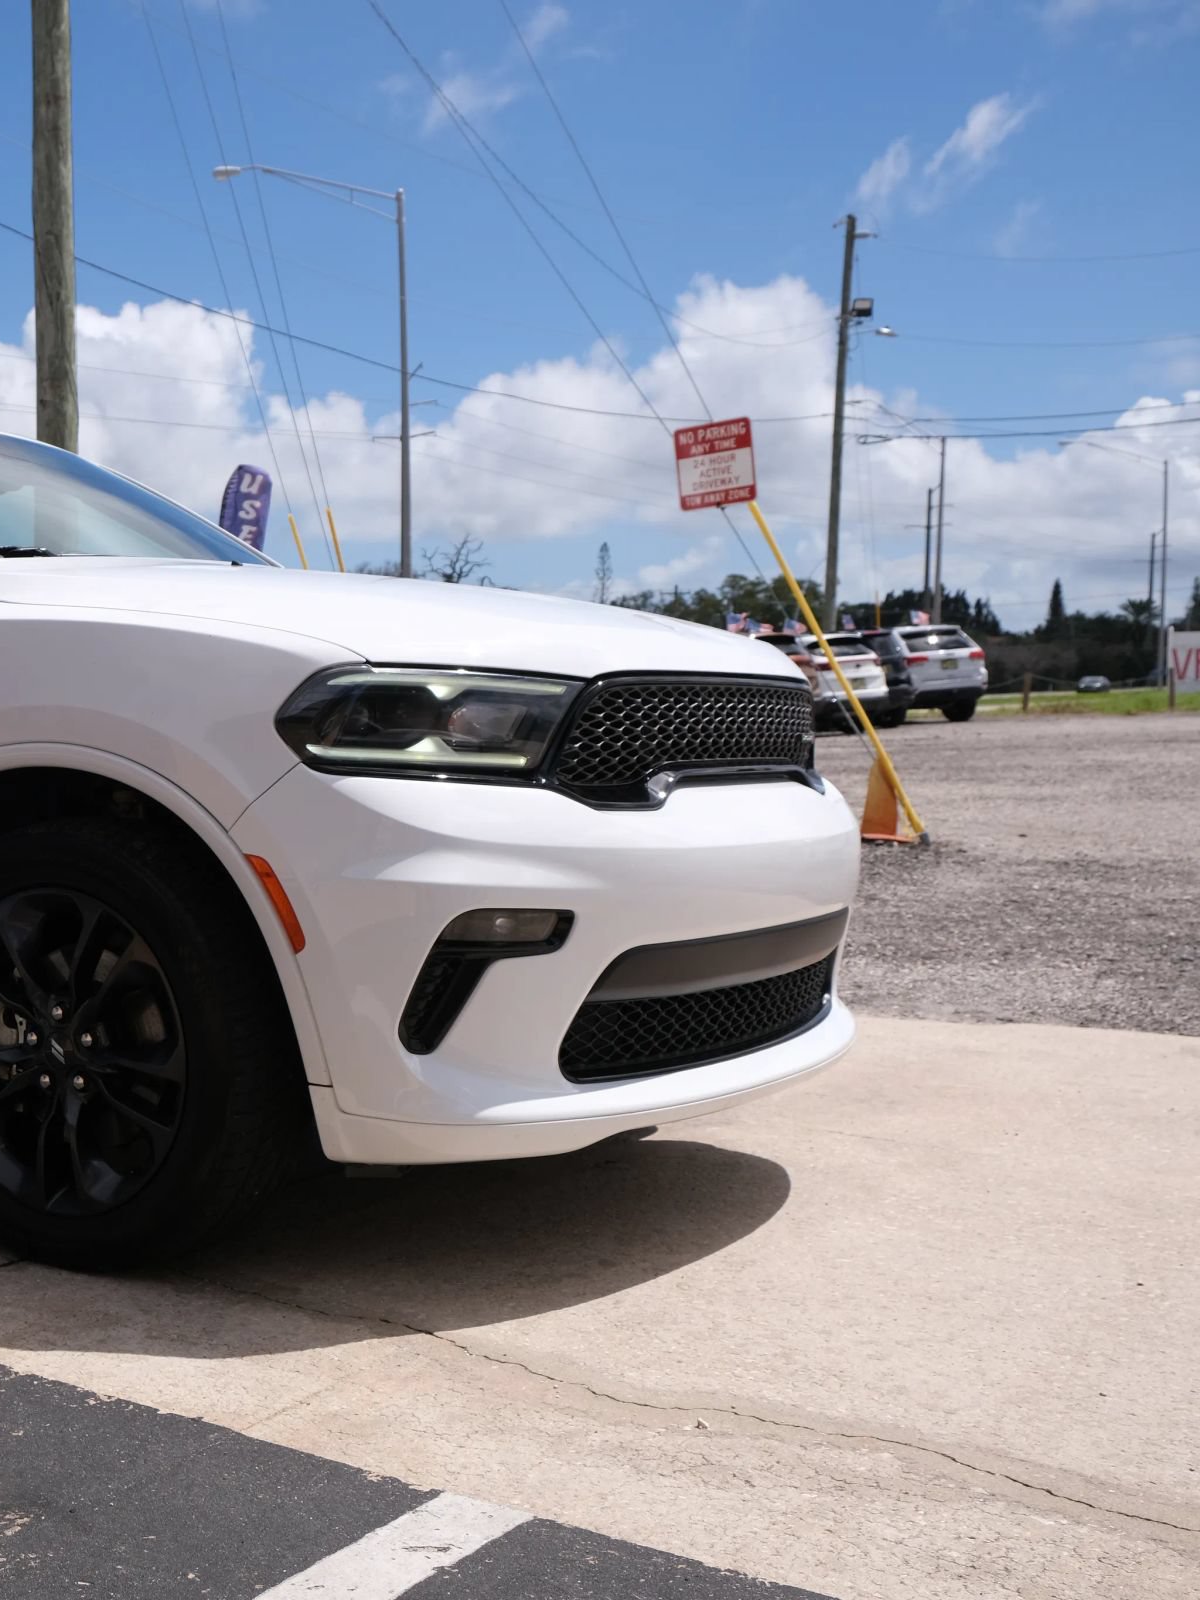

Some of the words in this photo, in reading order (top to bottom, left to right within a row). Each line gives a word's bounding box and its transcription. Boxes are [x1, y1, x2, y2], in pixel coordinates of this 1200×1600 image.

[679, 431, 694, 446] NO
[697, 423, 746, 442] PARKING
[690, 442, 710, 455] ANY
[714, 438, 737, 451] TIME
[693, 459, 705, 469] 24
[710, 454, 736, 465] HOUR
[700, 465, 733, 478] ACTIVE
[692, 476, 740, 491] DRIVEWAY
